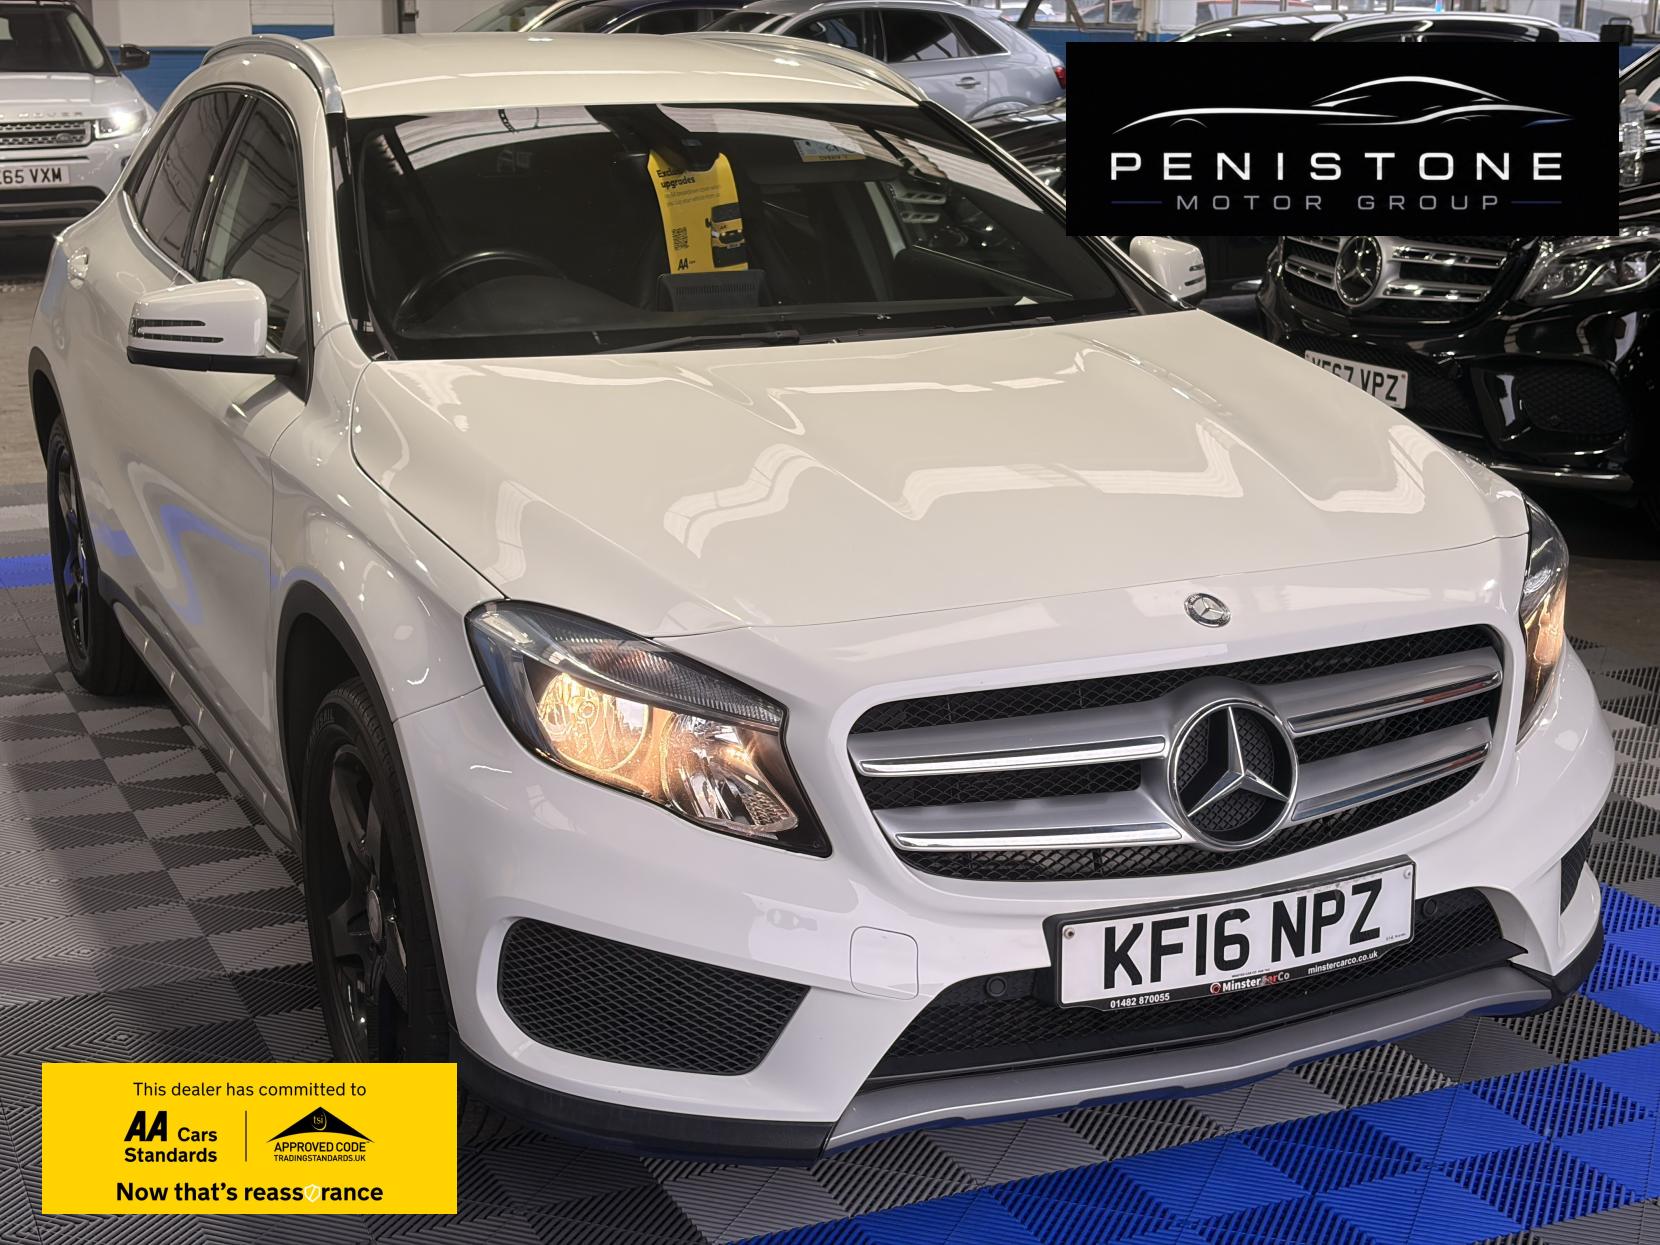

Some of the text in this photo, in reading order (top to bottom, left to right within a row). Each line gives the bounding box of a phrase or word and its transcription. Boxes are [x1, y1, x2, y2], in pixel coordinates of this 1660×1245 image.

[29, 168, 62, 183] VXM
[661, 176, 696, 190] upgrades
[677, 258, 689, 271] AA
[1360, 368, 1399, 402] VPZ
[1104, 878, 1383, 990] KF16 NPZ
[1307, 950, 1378, 975] minstercarco.co.uk
[1110, 992, 1170, 1009] 01482 870055
